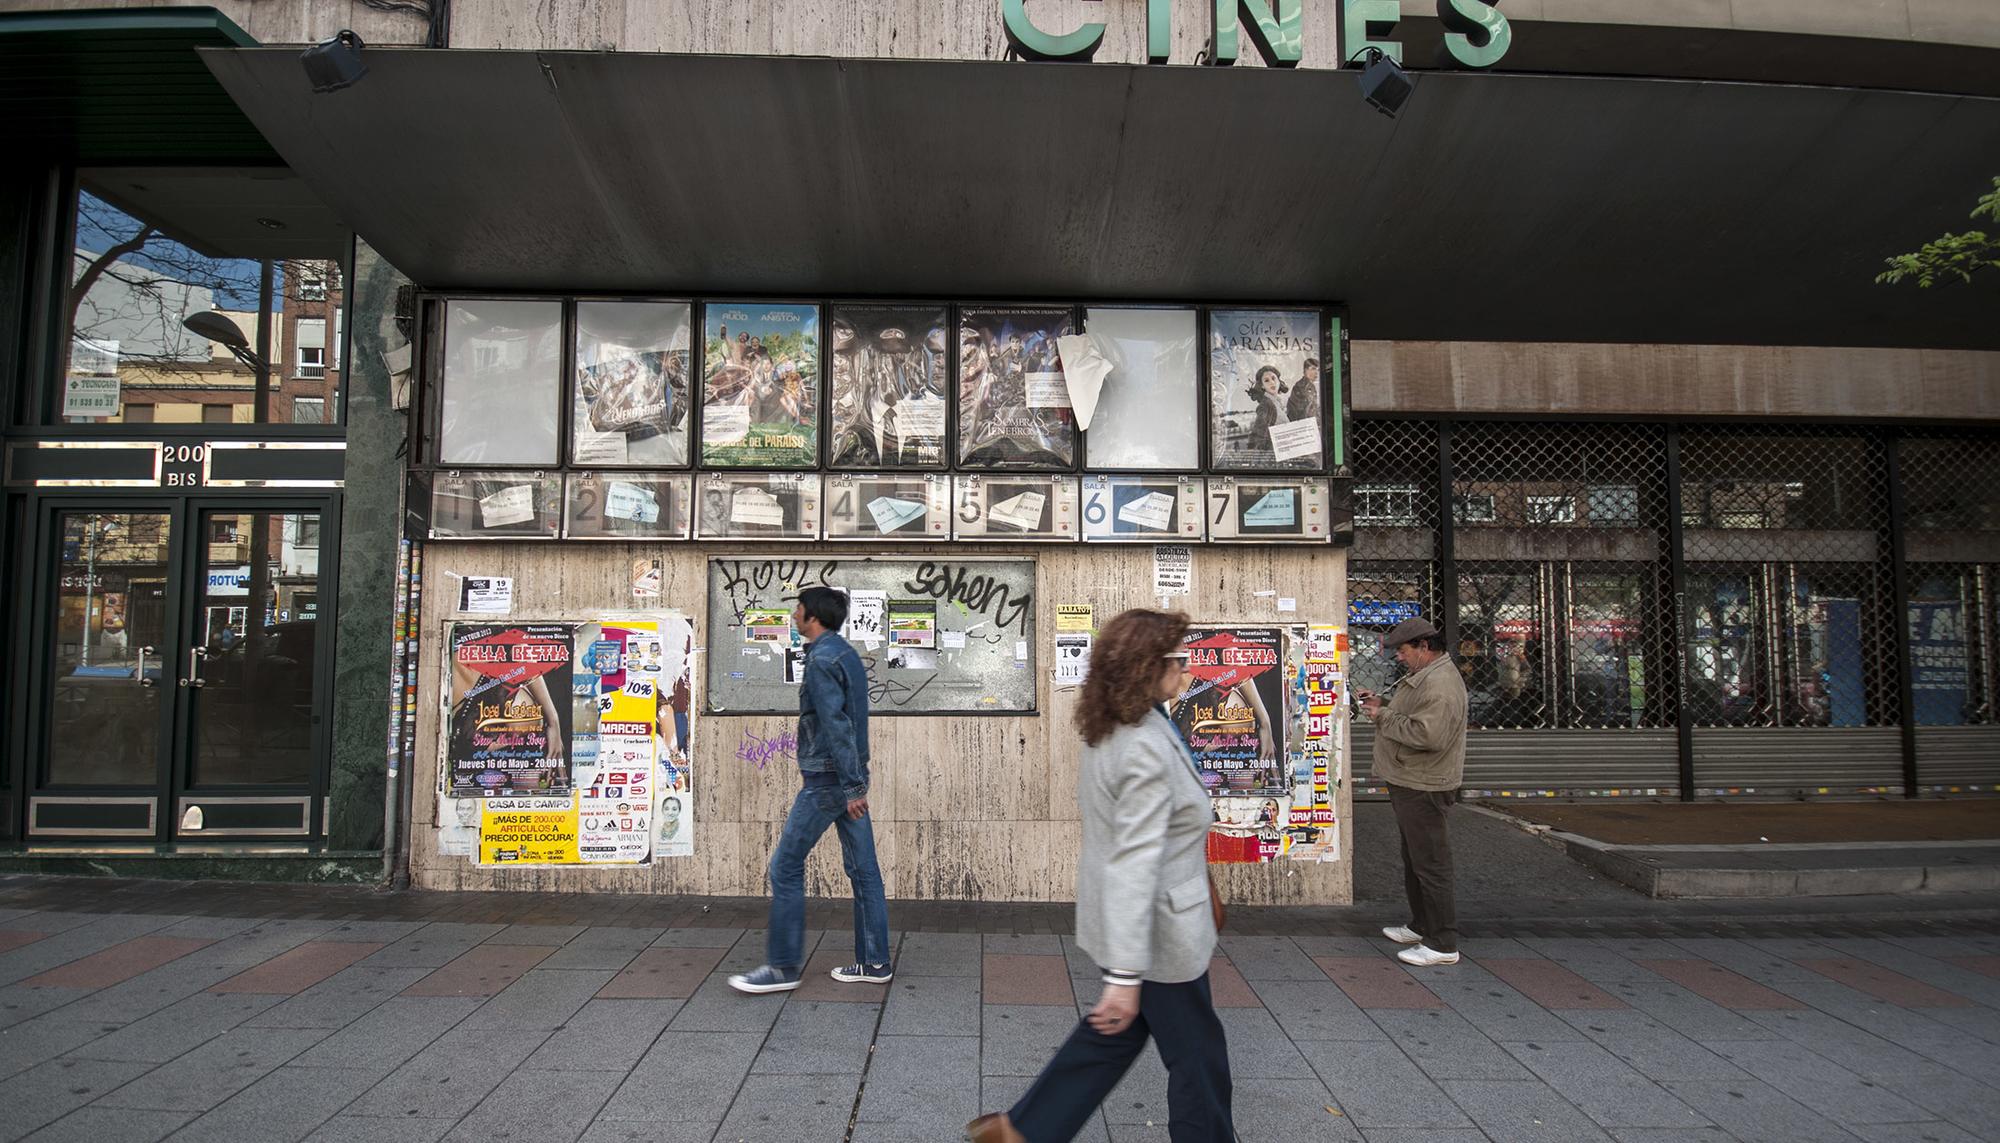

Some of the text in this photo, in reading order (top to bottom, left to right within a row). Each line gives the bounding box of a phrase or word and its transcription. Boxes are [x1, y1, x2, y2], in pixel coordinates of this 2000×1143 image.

[1003, 0, 1512, 67] CINES
[164, 445, 205, 464] 200
[167, 472, 197, 487] BIS
[831, 480, 854, 489] SALA
[450, 489, 460, 521] 1
[575, 489, 598, 522] 2
[831, 490, 855, 522] 4
[958, 491, 981, 524] 5
[1084, 492, 1106, 524] 6
[1211, 493, 1231, 525] 7
[458, 644, 570, 662] BELLA BESTIA
[1189, 648, 1278, 665] LLA BESTIA
[626, 682, 653, 696] 10%
[601, 723, 647, 735] MARCAS
[458, 760, 486, 769] Jueves
[486, 760, 496, 769] 16
[496, 760, 508, 769] de
[508, 760, 530, 771] Mayo
[1203, 760, 1213, 769] 16
[1213, 760, 1223, 769] de
[1223, 760, 1244, 772] Mayo
[488, 799, 572, 809] CASA DE CAMPO
[519, 815, 532, 824] DE
[552, 824, 560, 833] A
[485, 834, 519, 842] PRECIO
[520, 834, 533, 842] DE
[617, 834, 644, 842] ARMANI
